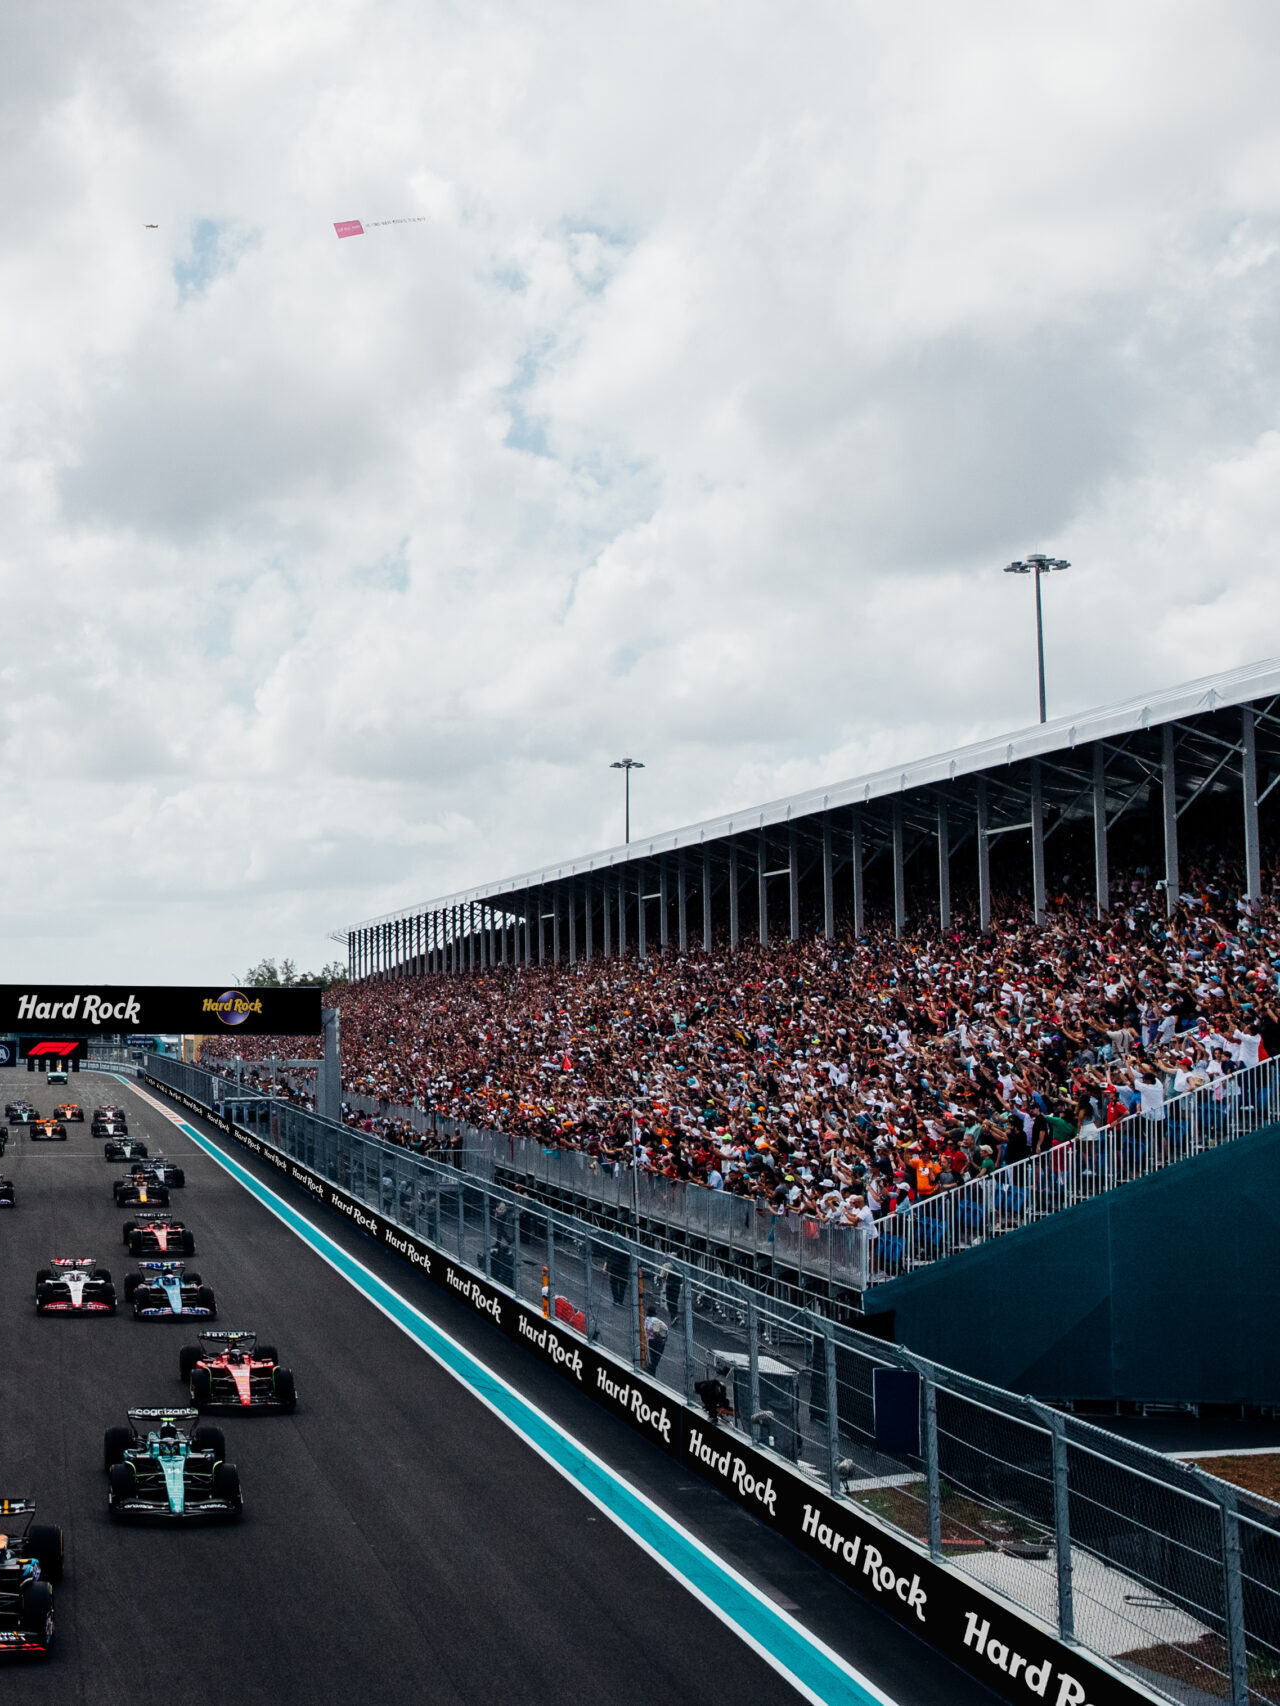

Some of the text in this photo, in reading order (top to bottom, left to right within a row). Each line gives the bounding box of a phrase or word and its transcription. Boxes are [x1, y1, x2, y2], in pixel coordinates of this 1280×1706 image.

[17, 995, 141, 1024] Hard Rock
[202, 998, 262, 1014] Hard Rock
[27, 1041, 79, 1056] F1
[331, 1193, 378, 1236] Hard Rock
[385, 1229, 431, 1274] Hard Rock
[446, 1267, 502, 1324] Hard Rock
[518, 1314, 584, 1381] Hard Rock
[596, 1367, 672, 1443] Hard Rock
[689, 1428, 777, 1517] Hard Rock
[801, 1503, 927, 1622] Hard Rock
[962, 1611, 1053, 1698] Hard
